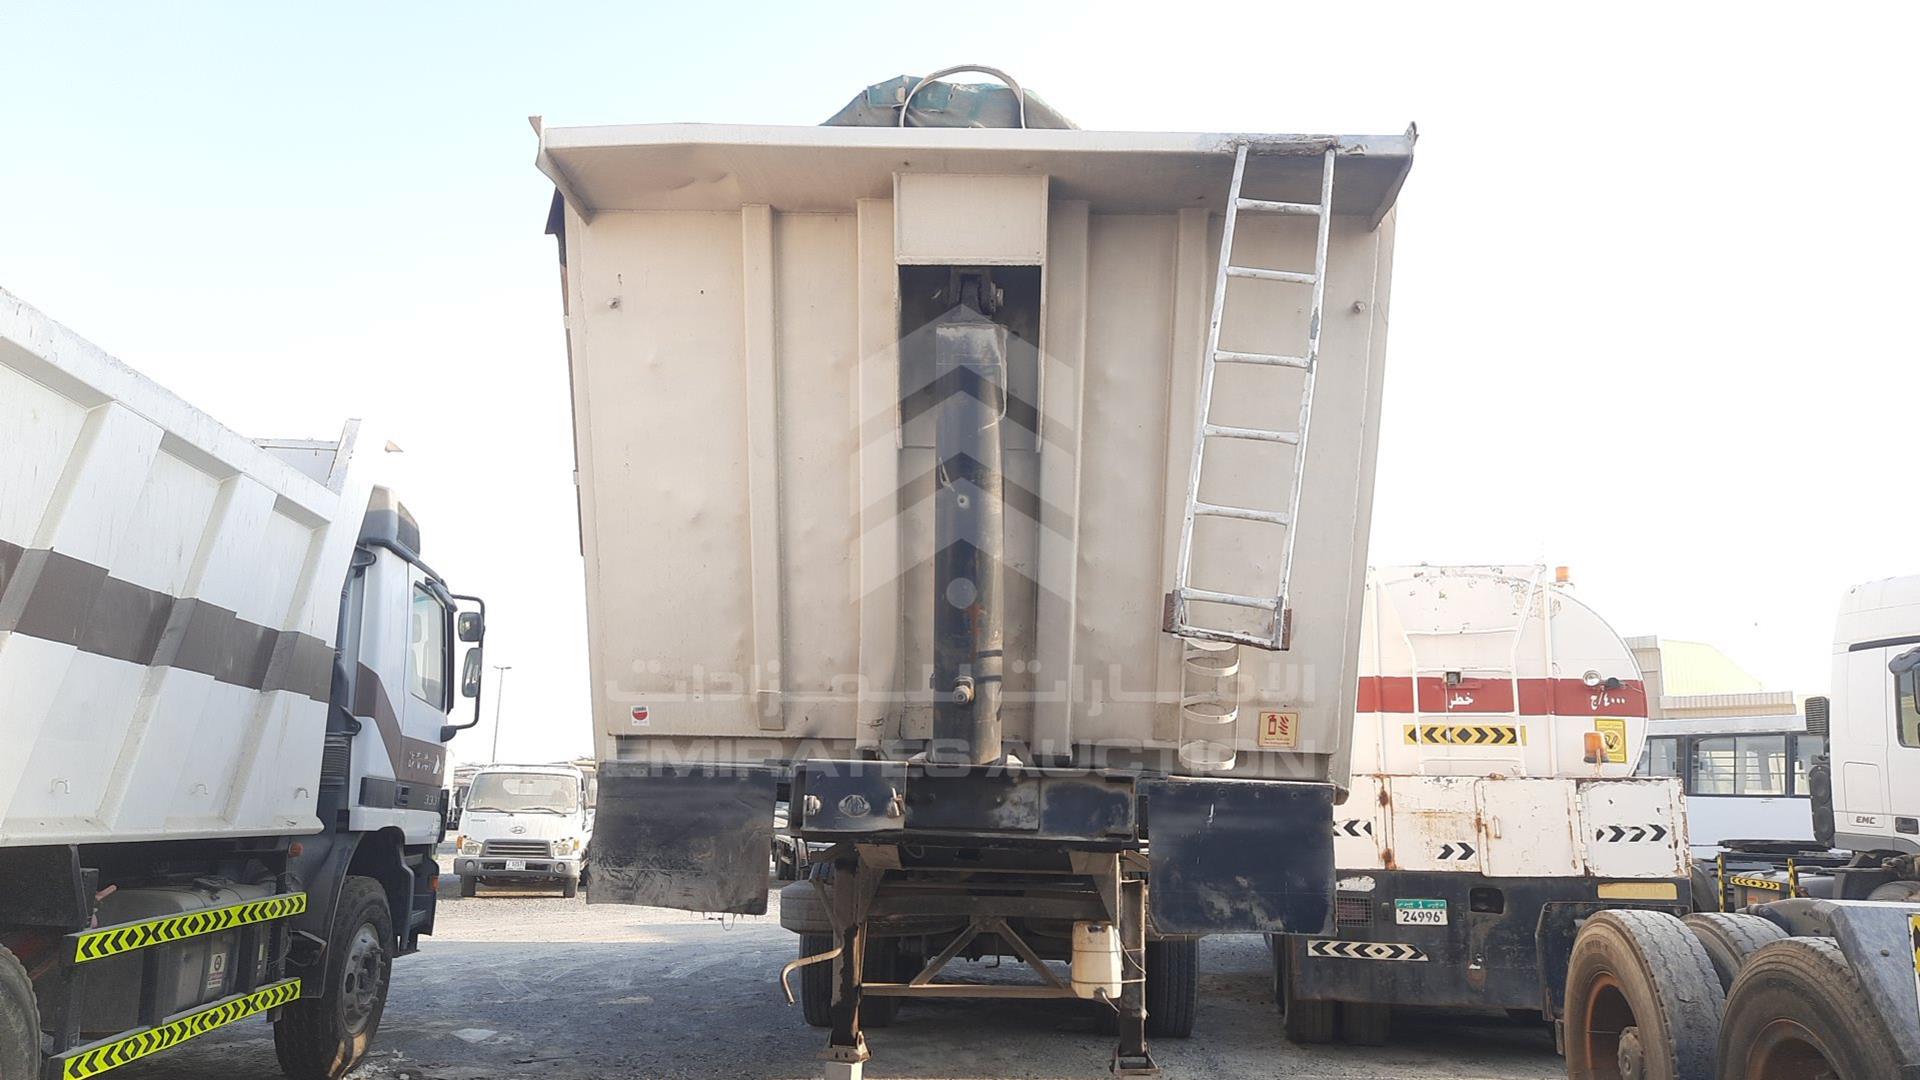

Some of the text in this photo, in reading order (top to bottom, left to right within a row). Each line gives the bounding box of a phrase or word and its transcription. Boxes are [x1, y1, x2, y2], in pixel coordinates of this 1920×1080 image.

[1449, 692, 1473, 709] خطر
[1856, 815, 1876, 824] EMC
[1402, 910, 1441, 923] 24996
